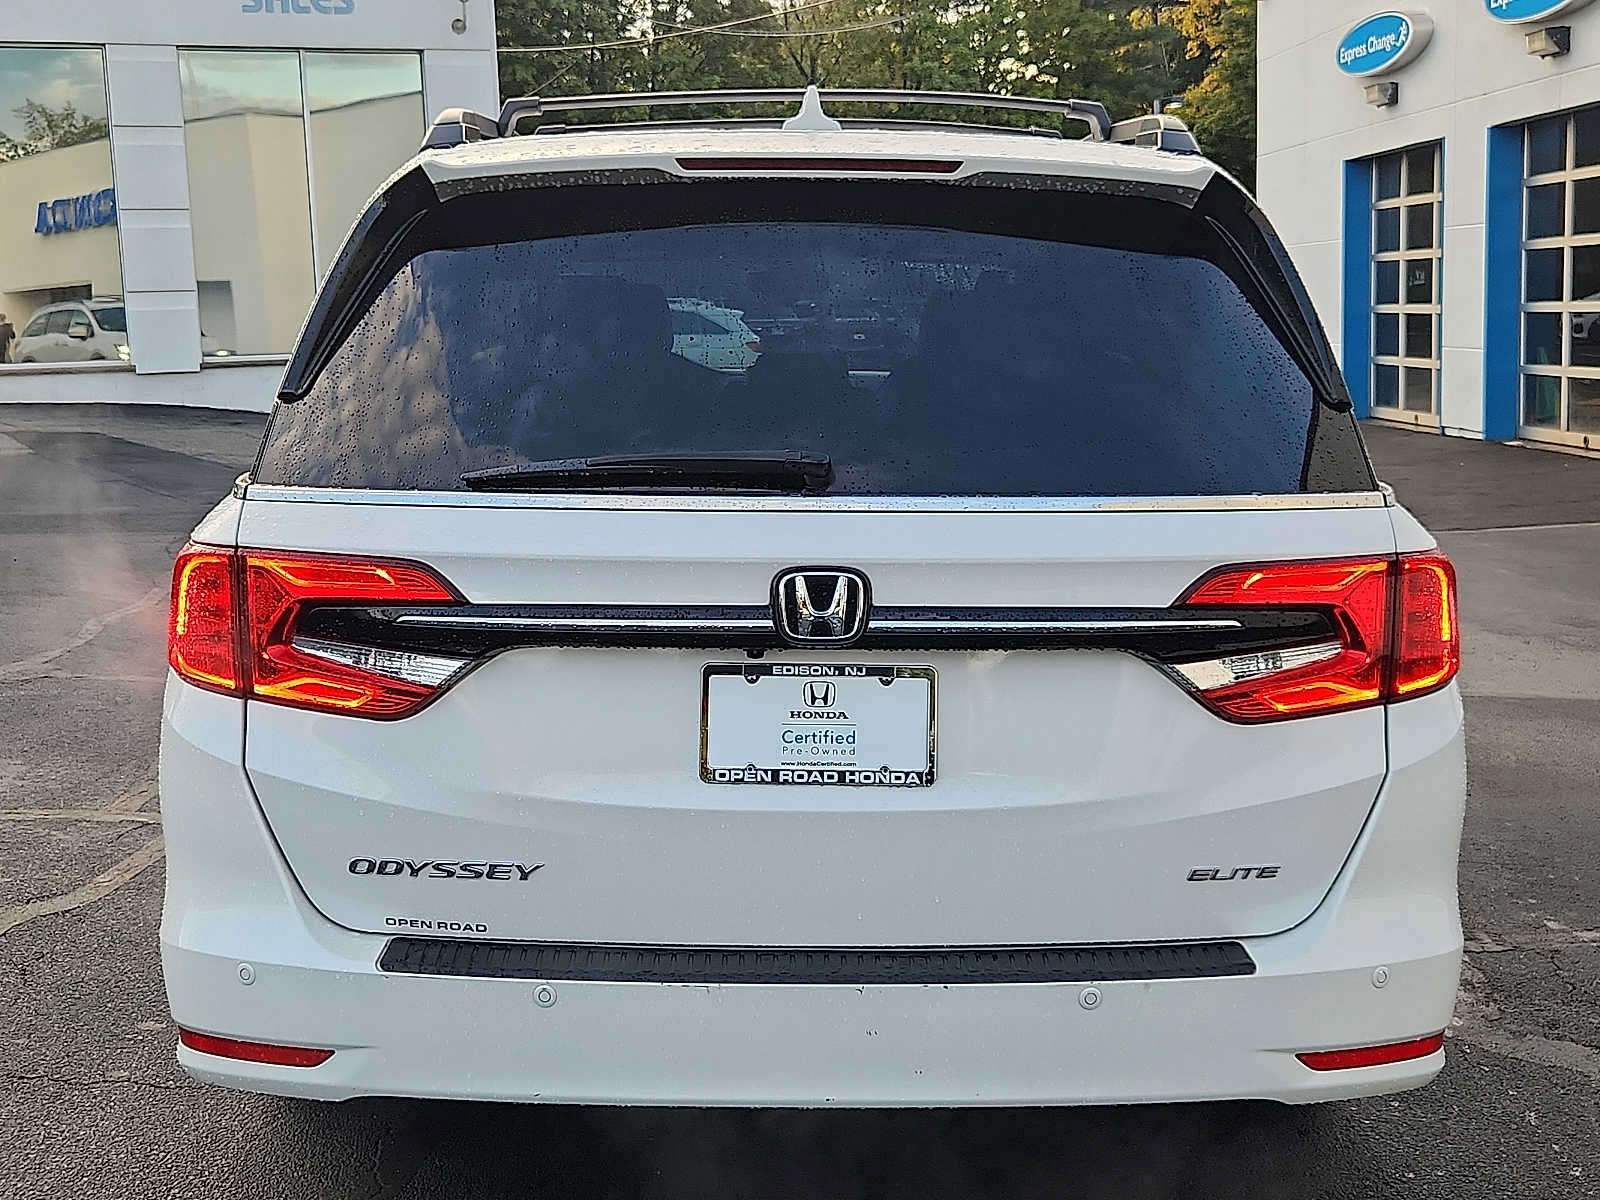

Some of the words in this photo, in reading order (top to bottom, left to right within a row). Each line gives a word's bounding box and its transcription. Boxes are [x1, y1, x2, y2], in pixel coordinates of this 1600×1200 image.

[1340, 44, 1367, 66] Express
[1367, 33, 1396, 53] Change
[772, 665, 840, 677] EDISON,
[844, 666, 867, 676] NJ
[789, 710, 849, 719] HONDA
[782, 729, 856, 744] Certified
[782, 746, 856, 756] Pre-Owned
[715, 768, 772, 782] OPEN
[779, 769, 839, 783] ROAD
[845, 770, 921, 784] HONDA
[348, 857, 545, 881] ODYSSEY
[1186, 866, 1281, 881] ELITE
[385, 917, 432, 929] OPEN
[437, 921, 488, 933] ROAD
